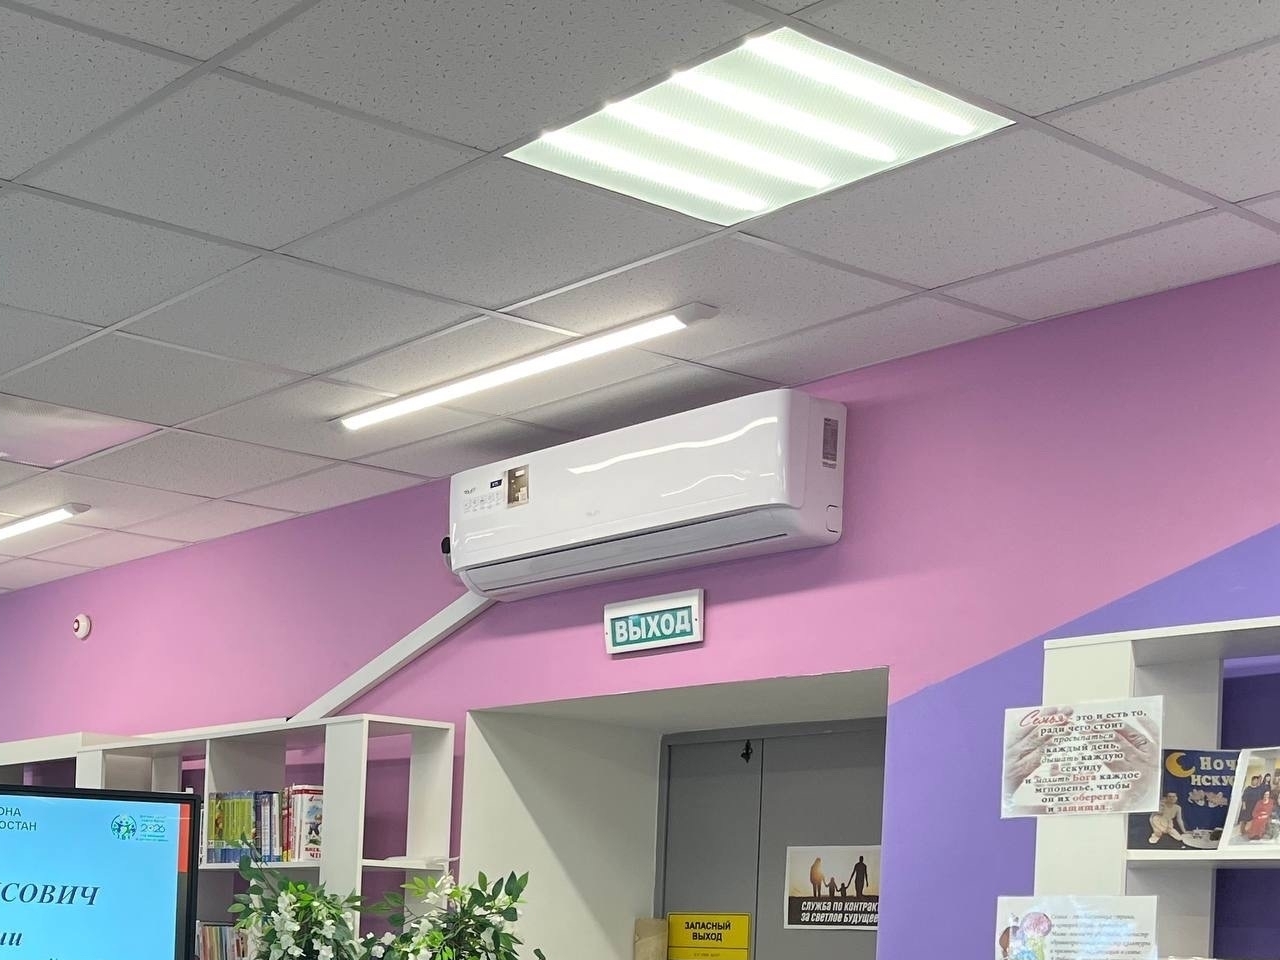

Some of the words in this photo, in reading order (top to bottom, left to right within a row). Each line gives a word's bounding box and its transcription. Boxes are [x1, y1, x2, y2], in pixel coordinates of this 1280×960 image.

[615, 609, 692, 644] ВЫХОД
[844, 902, 879, 911] КОНТРАК
[685, 921, 731, 930] ЗАПАСНЫЙ
[692, 932, 723, 942] ВЫХОД
